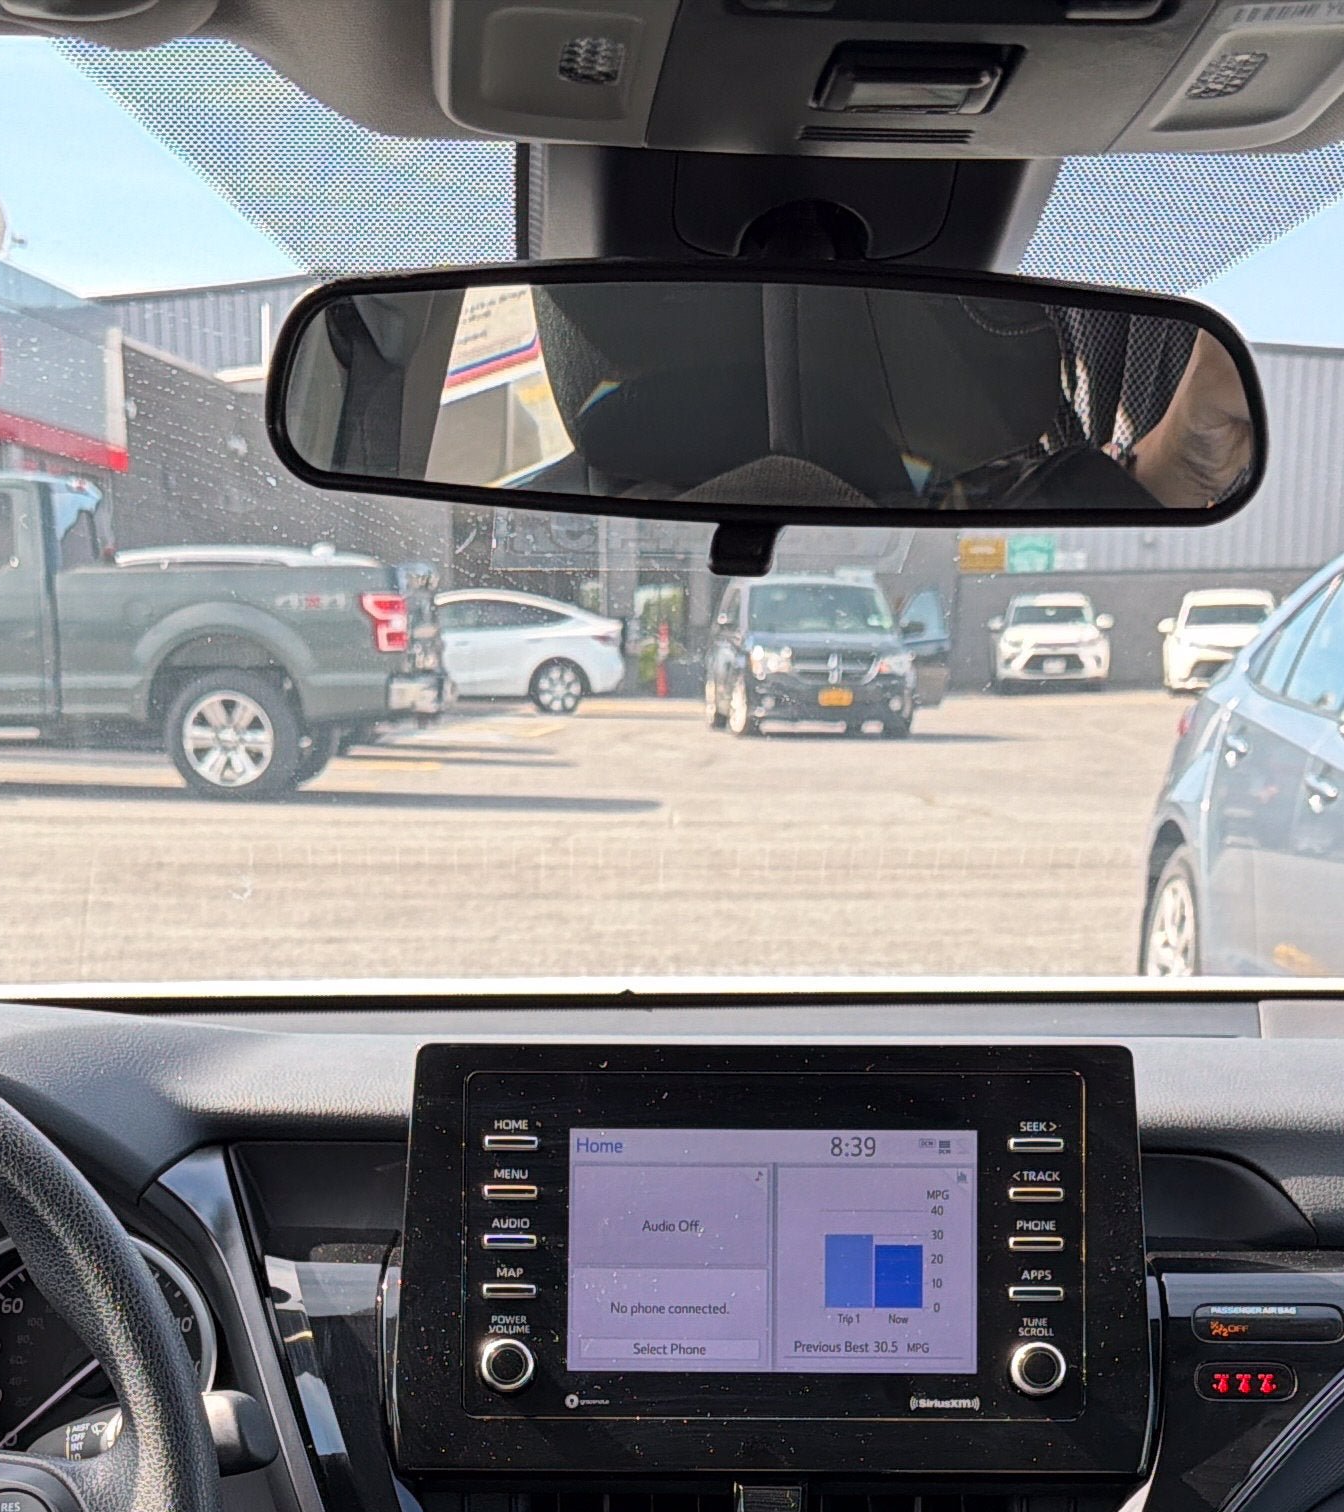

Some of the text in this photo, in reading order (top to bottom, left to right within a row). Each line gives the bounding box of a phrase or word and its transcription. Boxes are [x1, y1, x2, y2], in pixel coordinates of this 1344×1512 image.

[494, 1119, 529, 1130] HOME
[1019, 1121, 1047, 1132] SEEK
[576, 1137, 624, 1153] Home
[830, 1136, 876, 1157] 8:39
[493, 1168, 529, 1179] MENU
[1022, 1171, 1061, 1181] TRACK
[926, 1189, 950, 1200] MPG
[930, 1205, 944, 1216] 40
[491, 1217, 530, 1229] AUDIO
[641, 1219, 676, 1232] Audio
[1016, 1220, 1056, 1231] PHONE
[930, 1230, 944, 1240] 30
[930, 1254, 944, 1265] 20
[496, 1267, 524, 1278] MAP
[1021, 1269, 1052, 1281] APPS
[932, 1278, 943, 1288] 10
[1, 1297, 24, 1315] 60
[610, 1302, 730, 1317] No phone connected.
[933, 1303, 941, 1312] 0
[491, 1314, 527, 1324] POWER
[838, 1313, 854, 1326] Trip
[888, 1314, 909, 1324] Now
[1022, 1317, 1048, 1327] TUNE
[488, 1324, 530, 1334] VOLUME
[1018, 1327, 1055, 1337] SCROLL
[1228, 1324, 1249, 1333] OFF
[632, 1342, 707, 1355] Select Phone
[794, 1340, 930, 1353] Previous Best 30.5 MPG
[70, 1432, 86, 1442] OFF
[0, 1501, 21, 1512] RES
